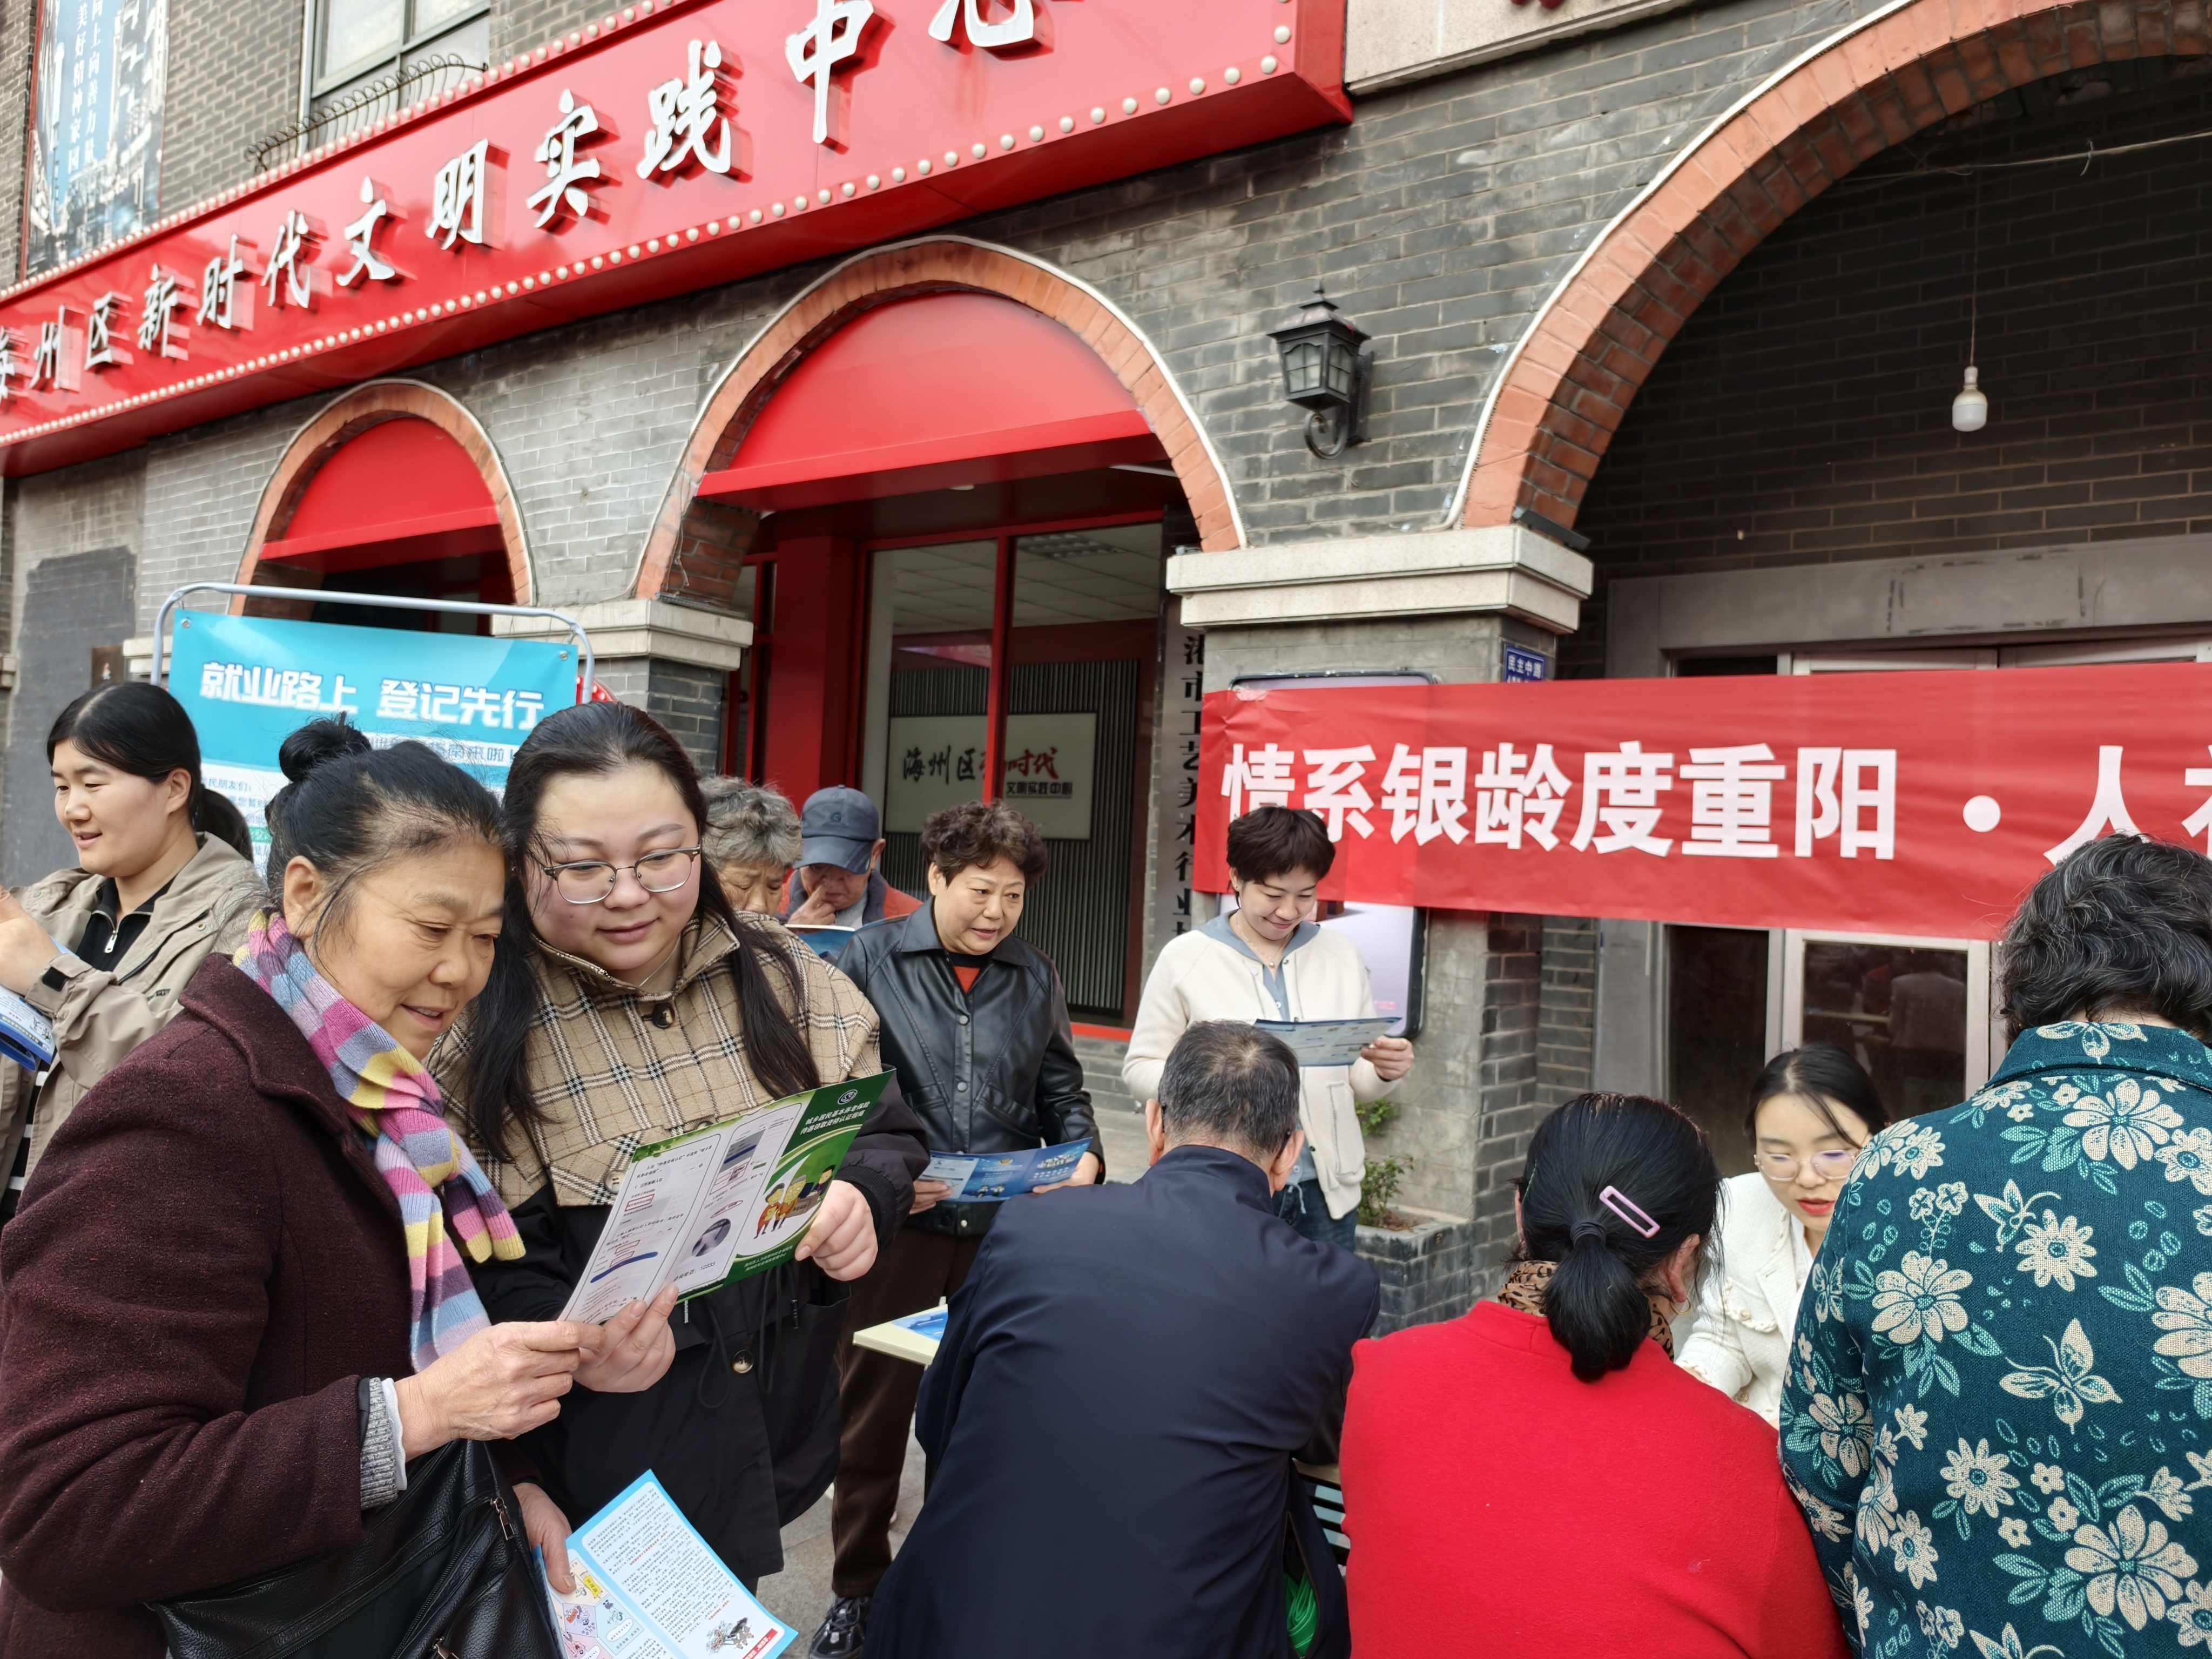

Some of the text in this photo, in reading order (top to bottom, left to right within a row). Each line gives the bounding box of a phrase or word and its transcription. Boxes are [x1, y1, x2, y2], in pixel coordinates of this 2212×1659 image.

[1508, 654, 1541, 679] 民主中路
[200, 662, 544, 730] 就业路上 登记先行
